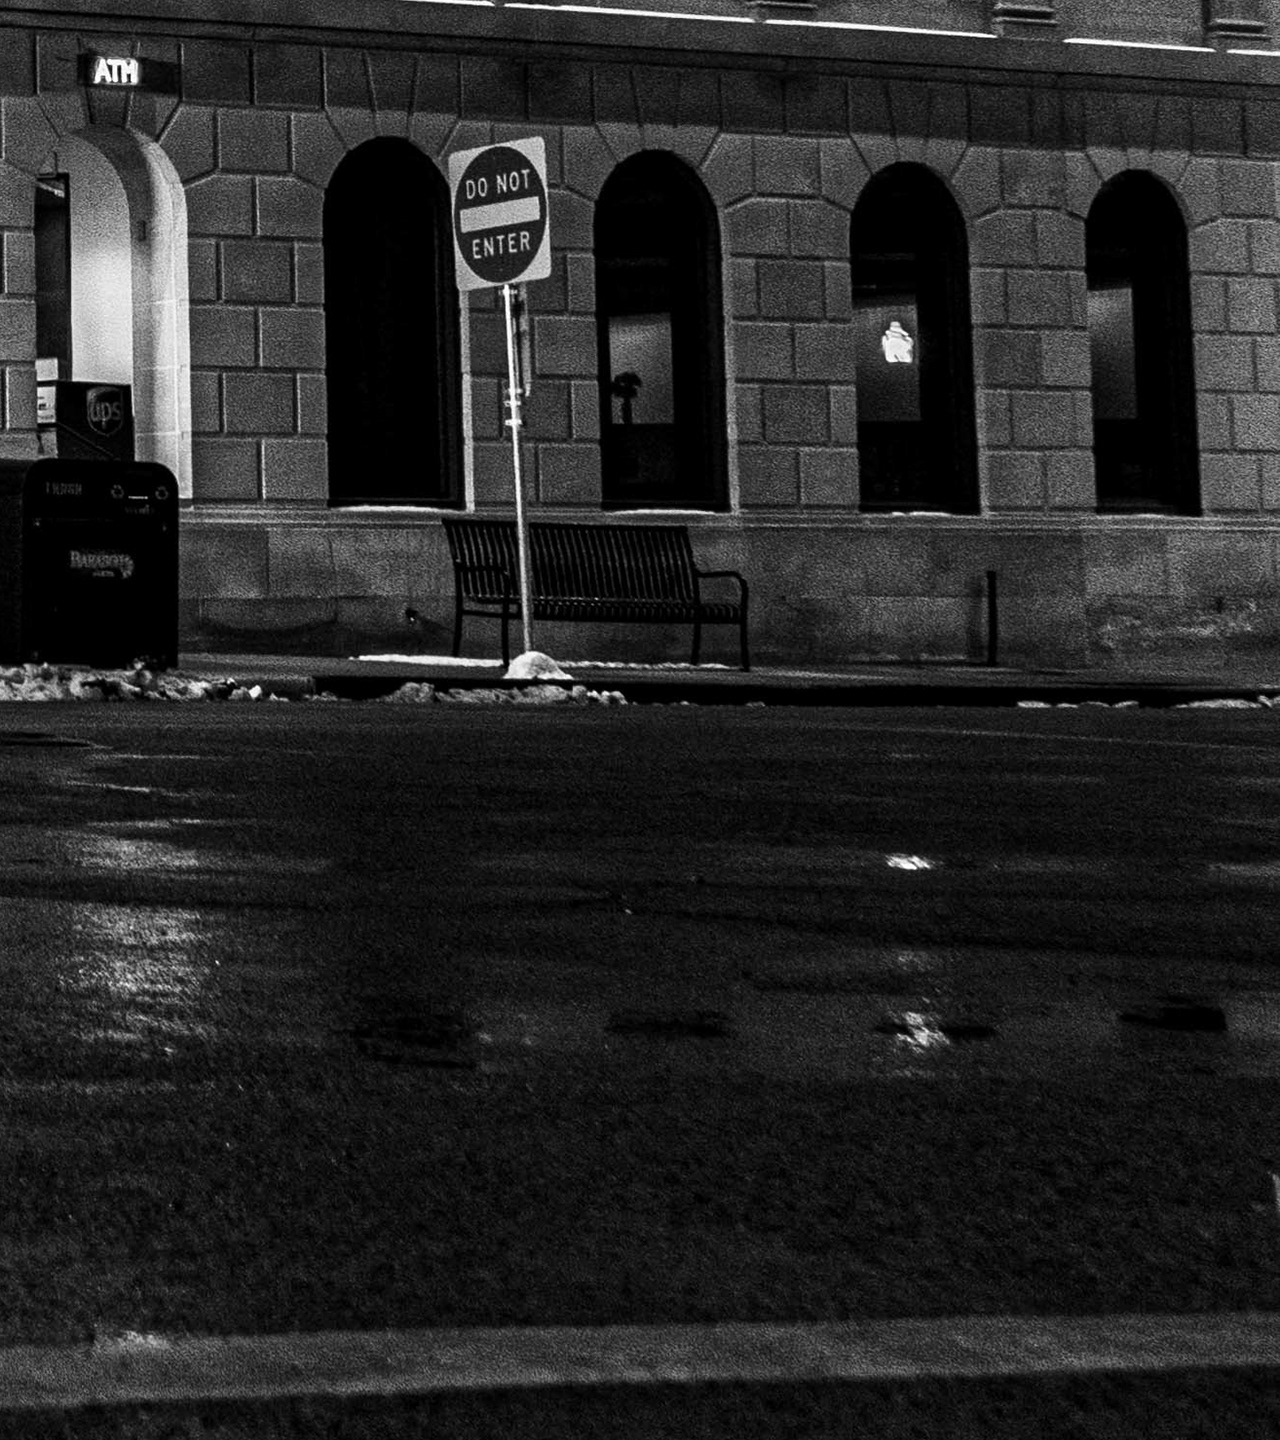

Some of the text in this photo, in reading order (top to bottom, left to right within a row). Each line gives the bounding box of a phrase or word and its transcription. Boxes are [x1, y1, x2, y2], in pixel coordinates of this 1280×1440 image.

[94, 57, 139, 85] ATM
[466, 169, 530, 200] DO NOT
[472, 231, 531, 259] ENTER
[90, 401, 121, 429] ups
